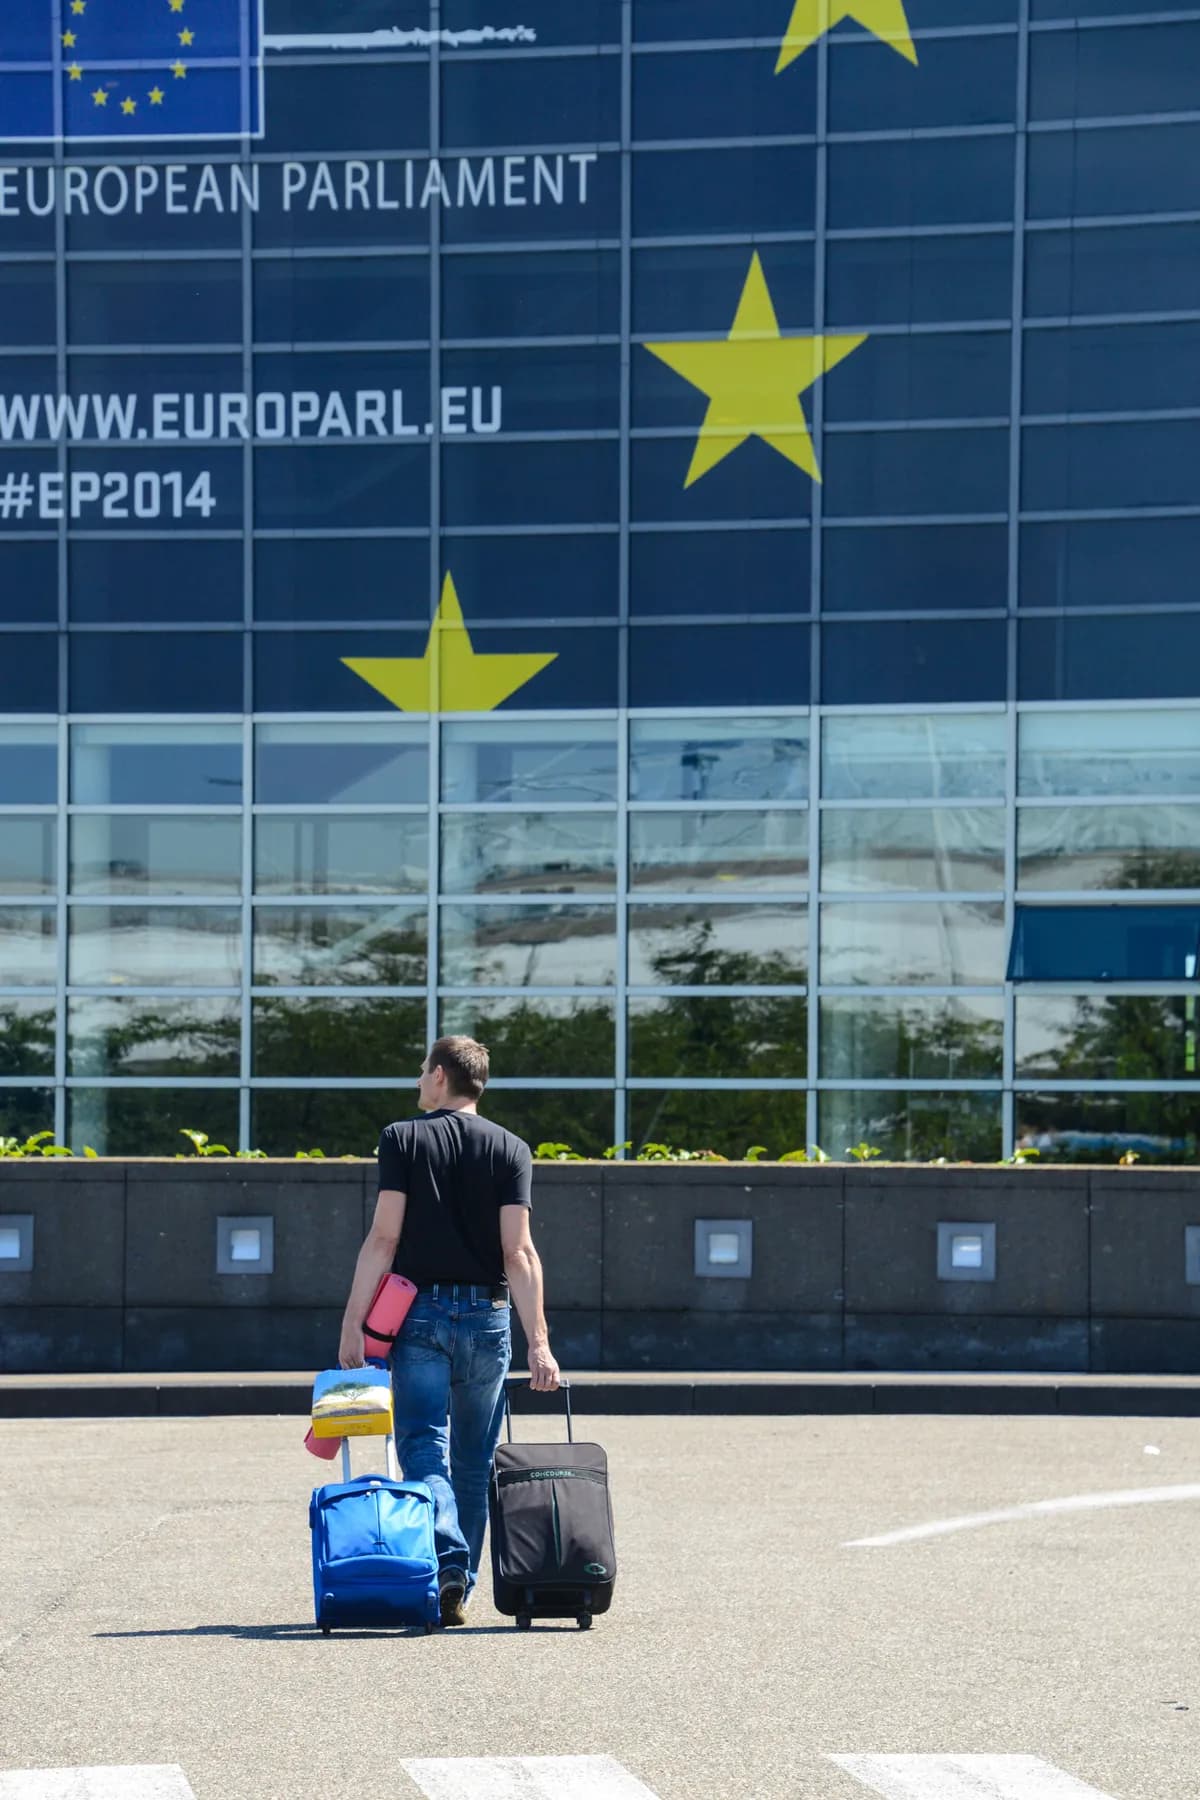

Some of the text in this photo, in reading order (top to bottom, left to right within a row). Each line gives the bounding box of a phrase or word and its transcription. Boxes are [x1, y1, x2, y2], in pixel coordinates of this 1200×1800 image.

[0, 153, 598, 216] EUROPEAN PARLIAMENT
[0, 386, 502, 441] WWW.EUROPARL.EU
[0, 471, 216, 519] #EP2014
